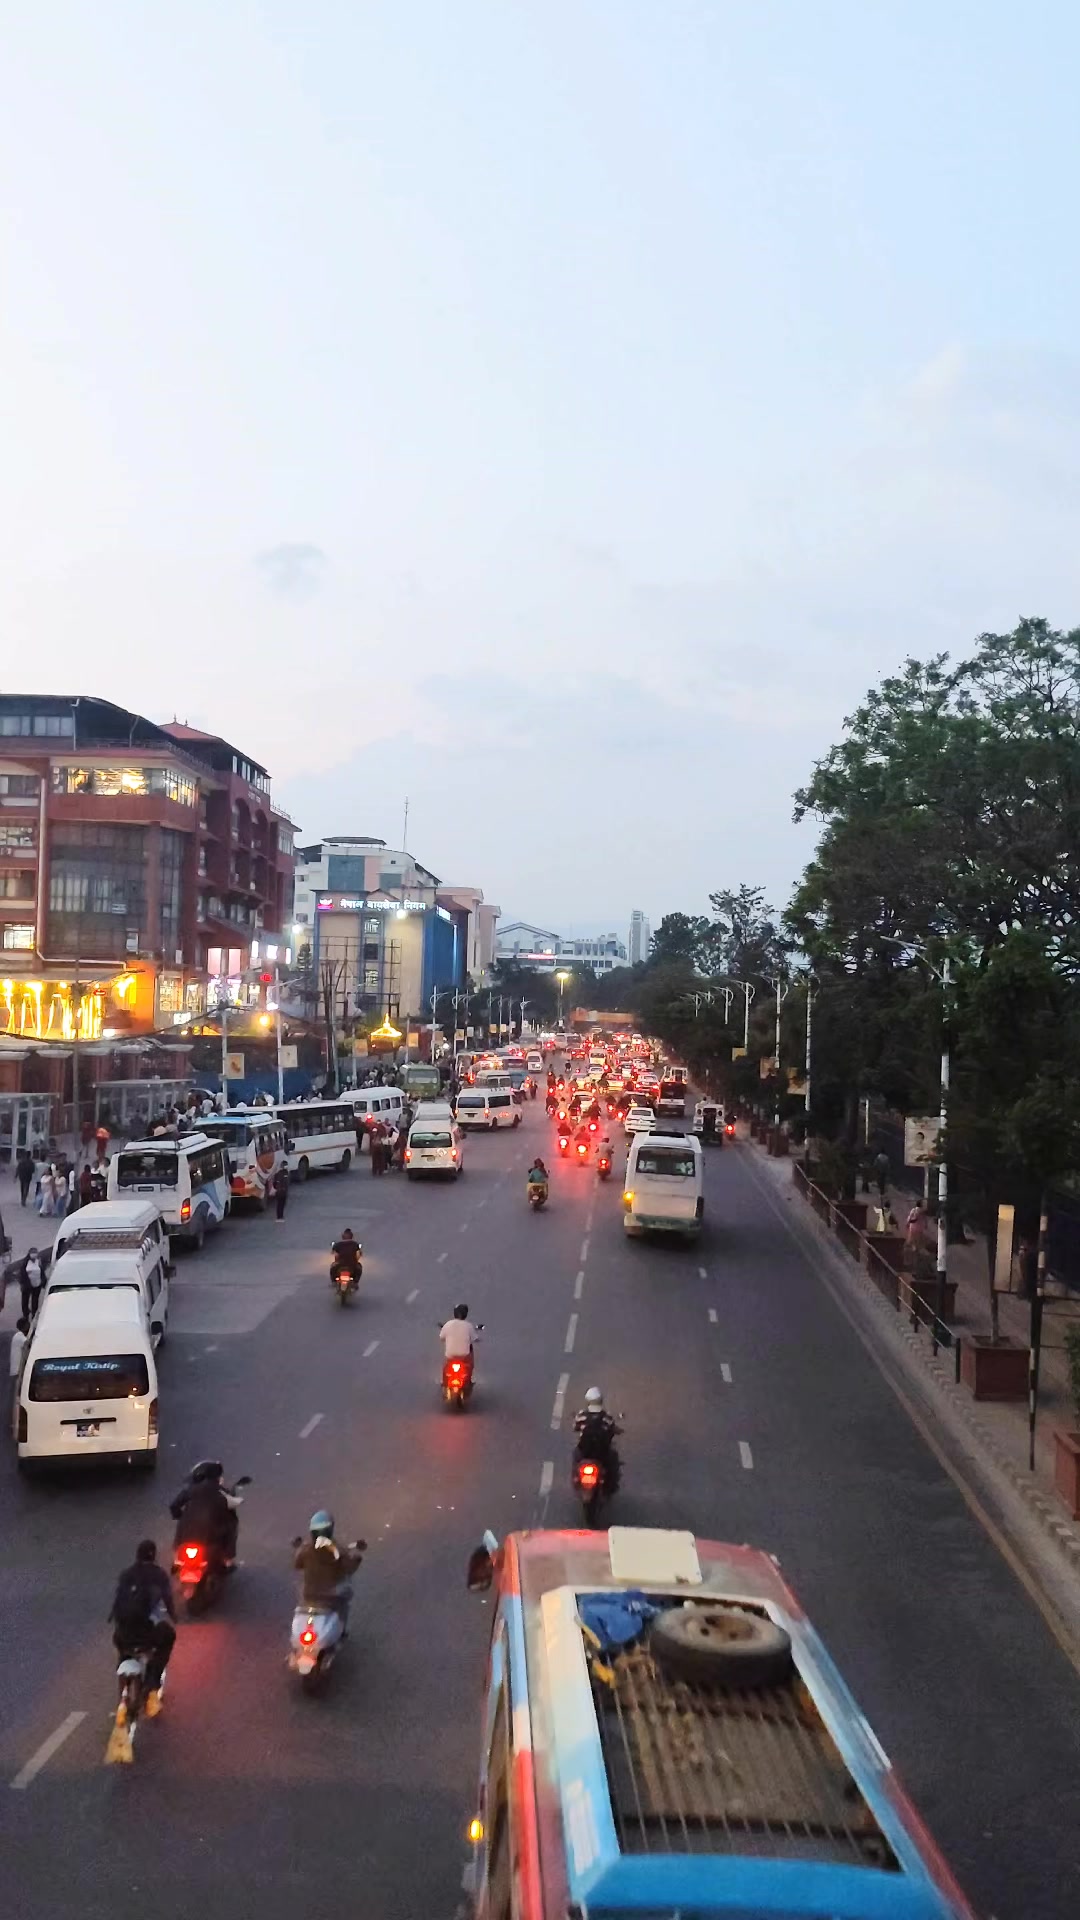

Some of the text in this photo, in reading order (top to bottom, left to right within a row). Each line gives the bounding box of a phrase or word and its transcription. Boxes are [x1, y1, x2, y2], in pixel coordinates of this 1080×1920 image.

[340, 898, 364, 908] नेपाल
[403, 899, 426, 910] निगम
[42, 1363, 79, 1372] Royal
